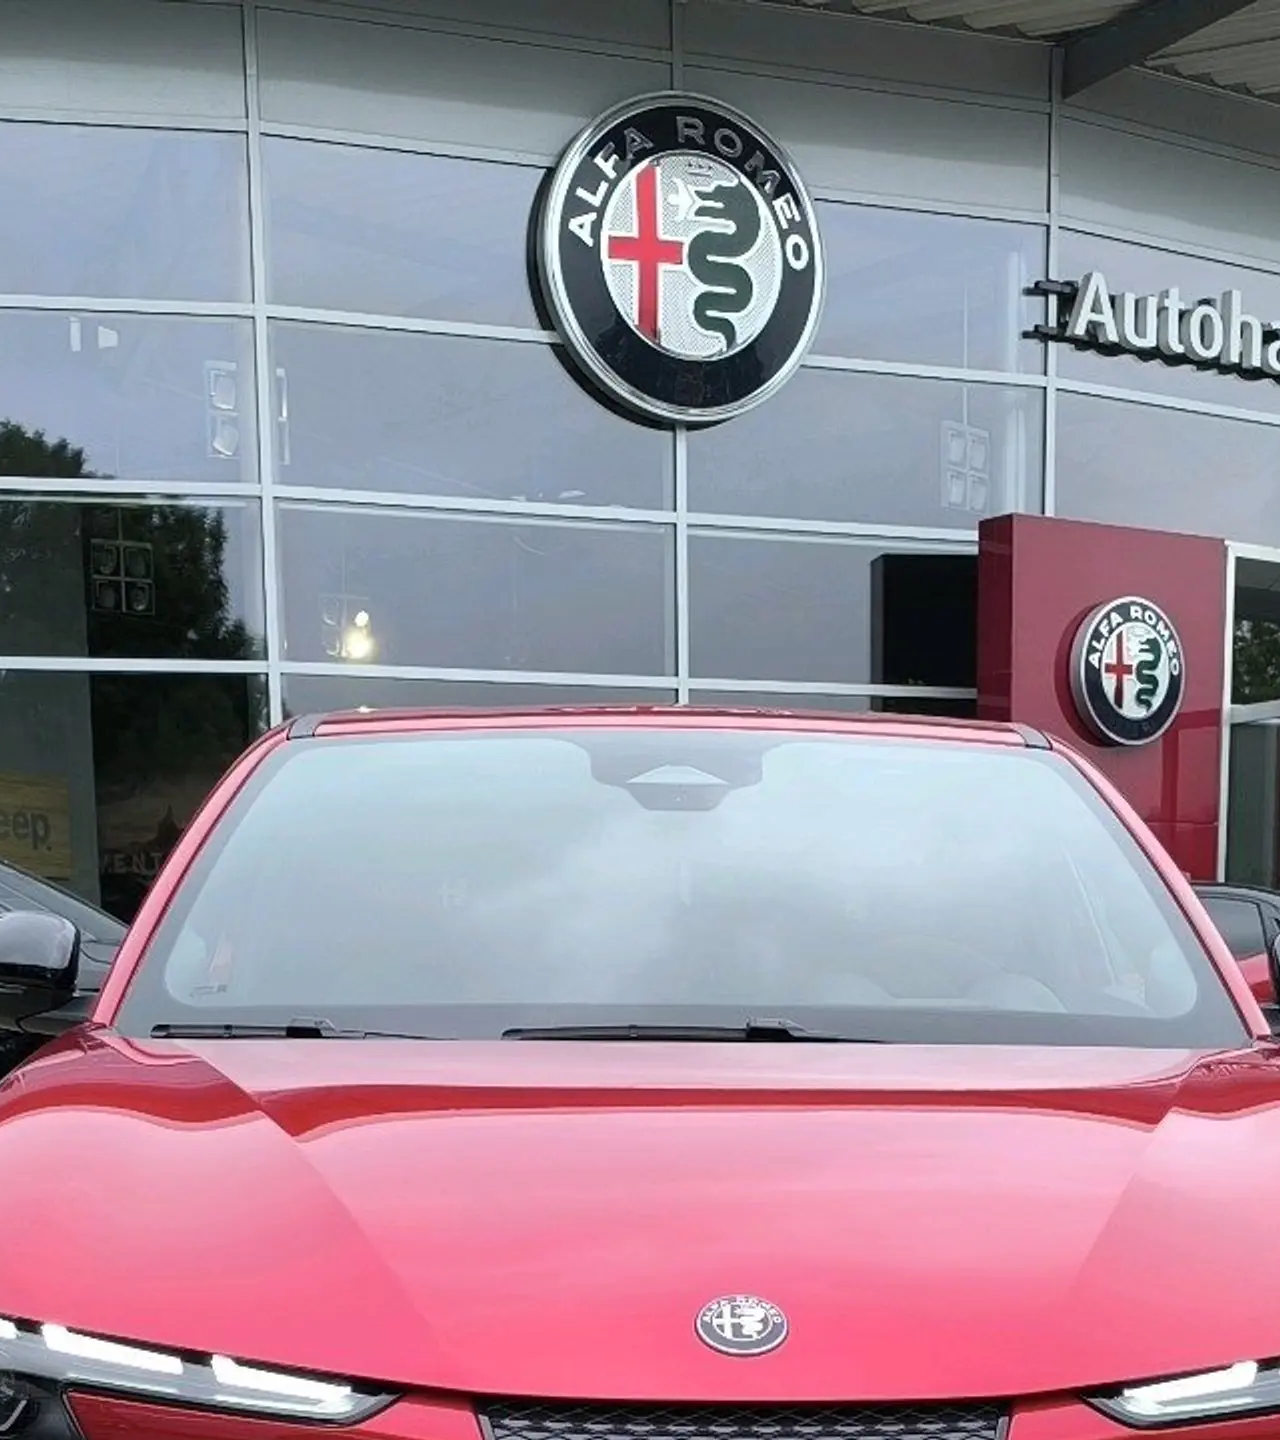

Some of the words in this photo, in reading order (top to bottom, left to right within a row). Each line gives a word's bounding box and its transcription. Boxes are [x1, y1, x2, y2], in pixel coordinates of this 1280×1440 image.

[567, 126, 655, 248] ALFA
[675, 116, 810, 272] ROMEO
[1087, 610, 1125, 671] ALFA
[1130, 605, 1181, 678] ROMEO
